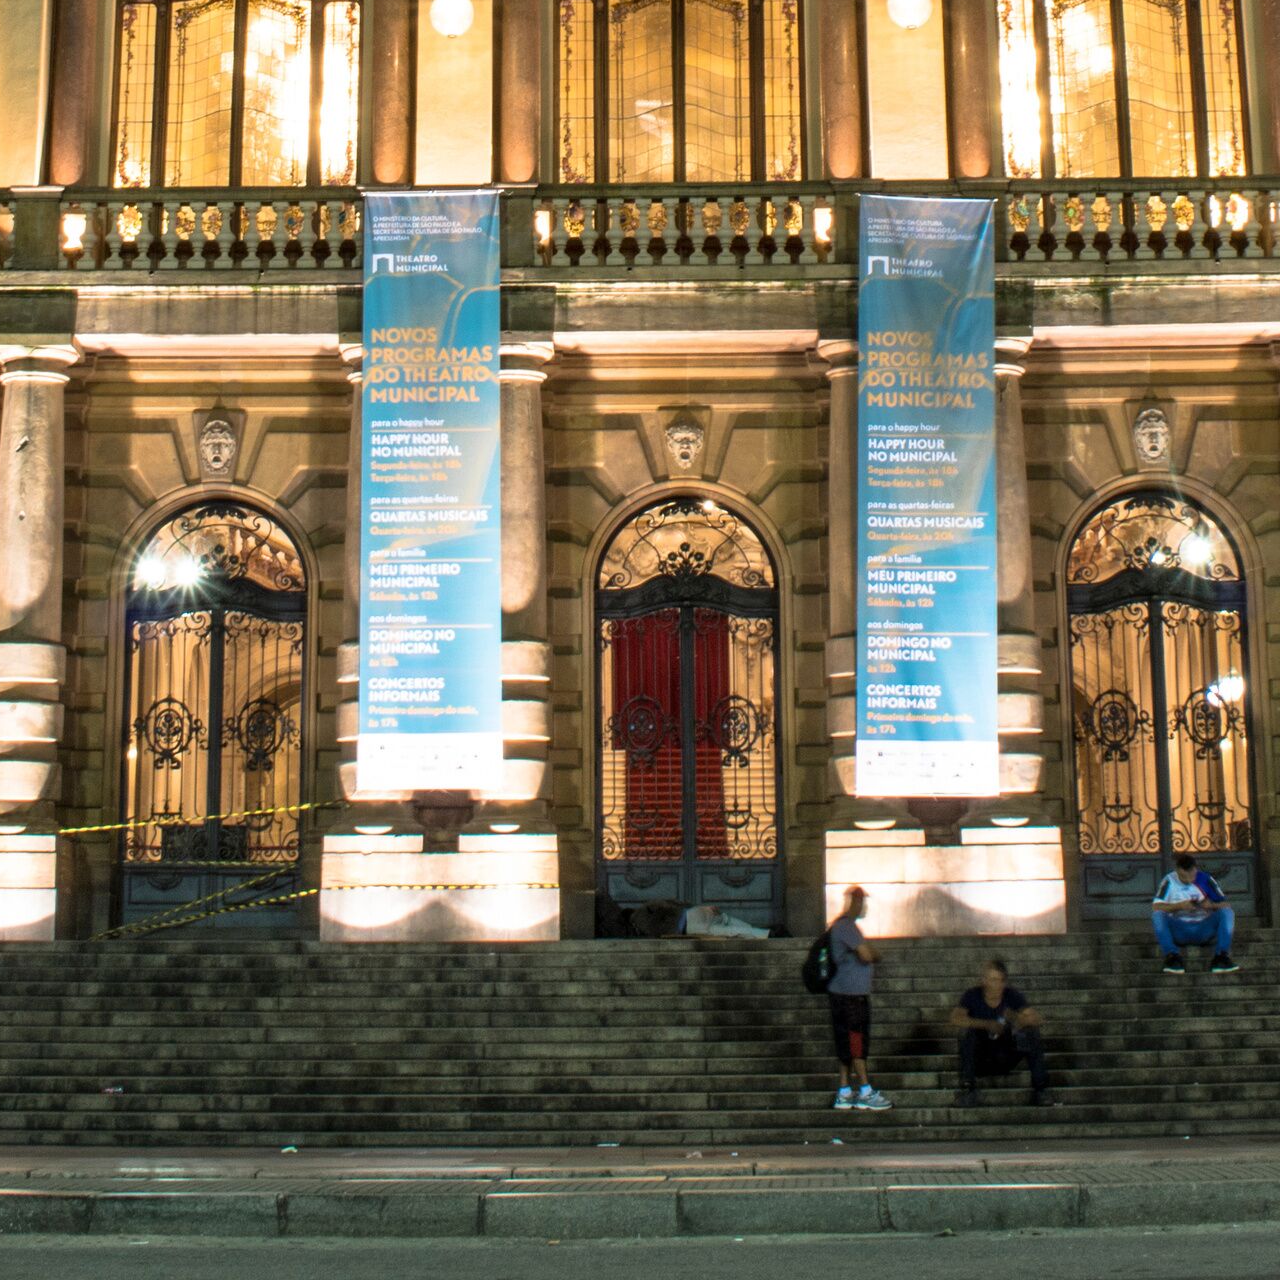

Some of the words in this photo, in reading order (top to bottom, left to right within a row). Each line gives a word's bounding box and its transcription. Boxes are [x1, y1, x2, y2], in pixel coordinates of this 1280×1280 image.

[396, 255, 438, 263] THEATRO
[892, 258, 933, 267] THEATRO
[396, 264, 448, 272] MUNICIPAL
[892, 268, 944, 277] MUNICIPAL
[371, 327, 437, 343] NOVOS
[867, 331, 933, 347] NOVOS
[371, 345, 493, 363] PROGRAMAS
[867, 351, 989, 369] PROGRAMAS
[371, 367, 400, 383] DO
[403, 365, 490, 382] THEATRO
[867, 370, 896, 387] DO
[900, 371, 986, 388] THEATRO
[371, 385, 480, 403] MUNICIPAL
[867, 391, 976, 409] MUNICIPAL
[372, 420, 390, 428] para
[399, 418, 424, 428] happy
[425, 418, 445, 426] hour
[868, 424, 886, 432] para
[895, 423, 919, 432] happy
[920, 423, 940, 431] hour
[372, 434, 410, 445] HAPPY
[412, 433, 449, 444] HOUR
[868, 439, 906, 449] HAPPY
[908, 439, 945, 449] HOUR
[372, 446, 391, 457] NO
[394, 445, 462, 457] MUNICIPAL
[868, 451, 887, 462] NO
[890, 451, 958, 462] MUNICIPAL
[371, 497, 390, 505] para
[403, 494, 458, 504] quartas-feiras
[868, 501, 887, 510] para
[888, 502, 897, 510] as
[899, 500, 955, 510] quartas-feiras
[371, 511, 426, 522] QUARTAS
[428, 510, 488, 522] MUSICAIS
[868, 516, 922, 528] QUARTAS
[924, 516, 985, 529] MUSICAIS
[867, 555, 886, 564] para
[371, 564, 398, 576] MEU
[400, 563, 461, 575] PRIMEIRO
[868, 569, 895, 581] MEU
[897, 570, 957, 582] PRIMEIRO
[371, 576, 440, 588] MUNICIPAL
[868, 583, 936, 595] MUNICIPAL
[369, 615, 385, 623] aos
[386, 613, 427, 624] domingos
[867, 621, 882, 629] aos
[883, 619, 924, 632] domingos
[370, 629, 433, 641] DOMINGO
[435, 629, 455, 641] NO
[369, 642, 440, 654] MUNICIPAL
[868, 636, 930, 648] DOMINGO
[931, 637, 952, 649] NO
[868, 649, 936, 661] MUNICIPAL
[369, 677, 445, 689] CONCERTOS
[369, 690, 440, 702] INFORMAIS
[867, 684, 942, 696] CONCERTOS
[867, 697, 937, 709] INFORMAIS
